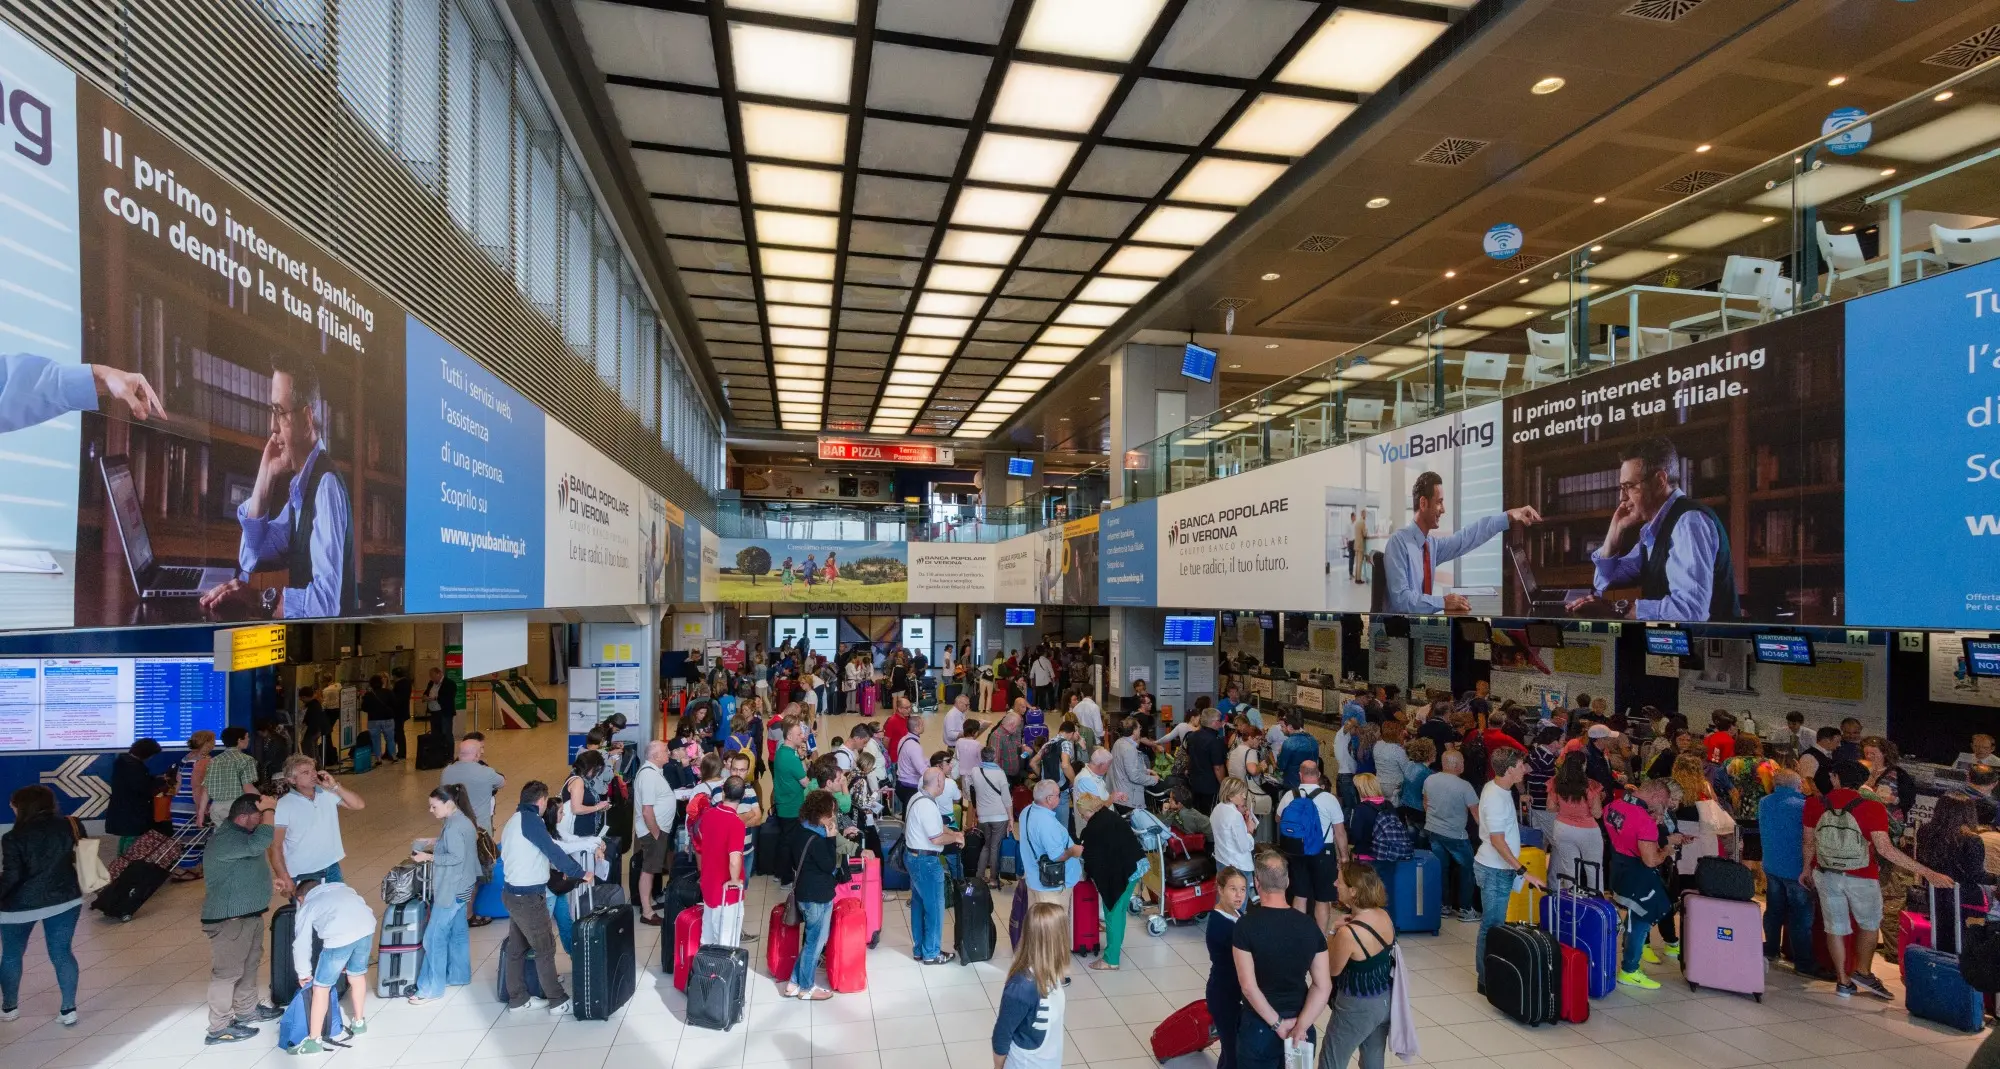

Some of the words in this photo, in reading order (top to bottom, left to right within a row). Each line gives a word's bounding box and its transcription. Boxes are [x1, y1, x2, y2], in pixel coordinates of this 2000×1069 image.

[103, 126, 123, 170] Il
[134, 154, 218, 227] primo
[225, 207, 308, 287] internet
[312, 266, 374, 333] banking
[103, 186, 160, 239] con
[168, 219, 252, 289] dentro
[258, 268, 277, 304] la
[281, 286, 313, 324] tua
[316, 305, 366, 354] filiale.
[440, 357, 463, 391] Tutti
[465, 372, 468, 394] i
[469, 382, 495, 410] servizi
[495, 397, 513, 424] web,
[1512, 406, 1522, 424] Il
[1526, 396, 1576, 422] primo
[1581, 371, 1662, 407] internet
[1667, 347, 1766, 385] banking
[441, 397, 489, 443] l'assistenza
[1511, 427, 1540, 444] con
[1543, 412, 1603, 437] dentro
[1608, 404, 1626, 424] la
[1631, 397, 1666, 419] tua
[1672, 379, 1749, 409] filiale.
[823, 445, 846, 456] BAR
[851, 446, 882, 458] PIZZA
[1378, 421, 1494, 465] YouBanking
[441, 440, 451, 464] di
[453, 450, 470, 471] una
[472, 458, 505, 484] persona.
[441, 481, 477, 512] Scoprilo
[478, 497, 488, 514] su
[570, 475, 598, 502] BANCA
[598, 490, 630, 517] POPOLARE
[569, 497, 579, 515] DI
[580, 501, 610, 526] VERONA
[1179, 512, 1215, 530] BANCA
[1218, 497, 1289, 523] POPOLARE
[440, 526, 526, 559] www.youbanking.it
[569, 539, 577, 560] Le
[1179, 532, 1190, 545] DI
[1192, 525, 1238, 543] VERONA
[1208, 541, 1236, 553] BANCO
[1240, 535, 1289, 549] POPOLARE
[1180, 562, 1188, 576] Le
[1189, 563, 1201, 576] tue
[1202, 557, 1227, 576] radici,
[1229, 556, 1235, 573] il
[1237, 558, 1253, 573] tuo
[1255, 553, 1289, 572] futuro.
[808, 603, 892, 612] CAMICISSIMA
[1965, 603, 1980, 611] Per
[1983, 603, 1993, 611] le
[1580, 624, 1590, 633] 12
[1609, 625, 1620, 634] 13
[1757, 634, 1804, 642] FUERTEVENTURA
[1849, 635, 1864, 646] 14
[1903, 636, 1920, 648] 15
